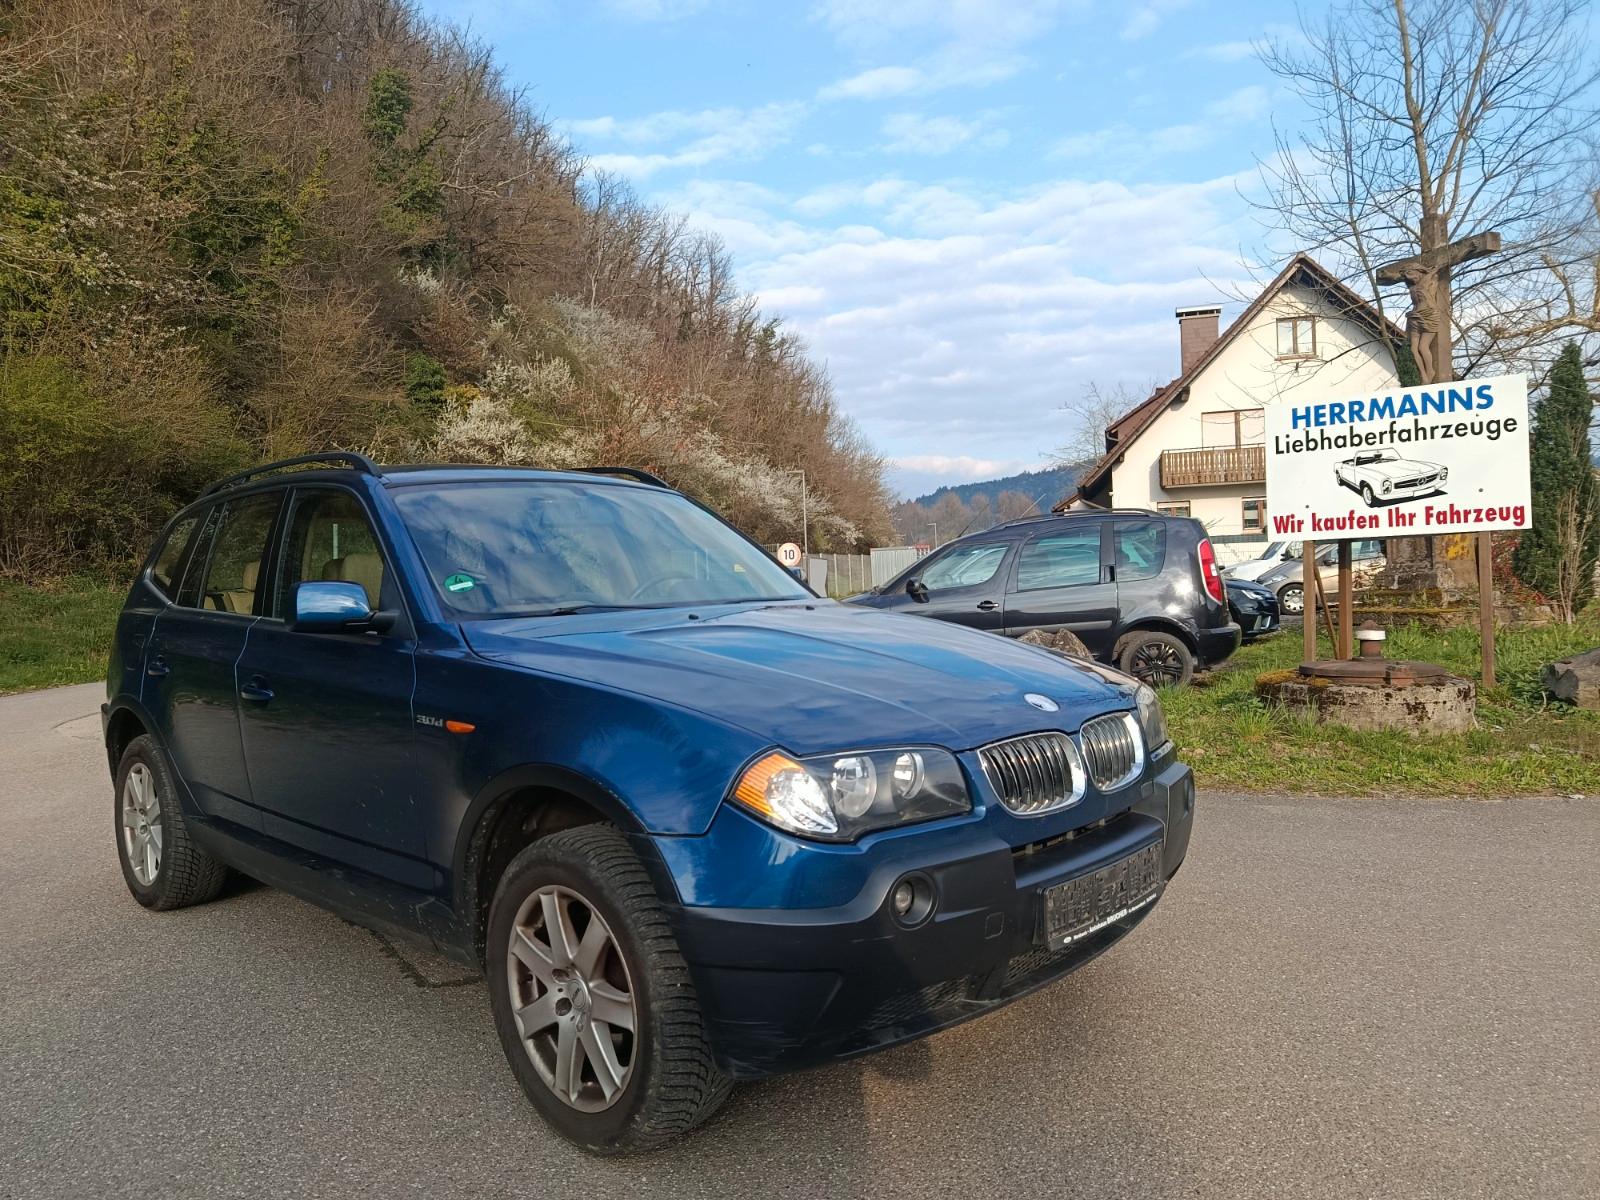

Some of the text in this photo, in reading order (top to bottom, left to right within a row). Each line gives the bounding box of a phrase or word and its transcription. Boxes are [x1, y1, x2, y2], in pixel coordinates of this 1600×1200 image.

[1291, 384, 1494, 430] HERRMANNS
[1275, 417, 1518, 455] Liebhaberfahrzeuge
[1273, 504, 1526, 534] Wir kaufen Ihr Fahrzeug
[784, 549, 795, 560] 10
